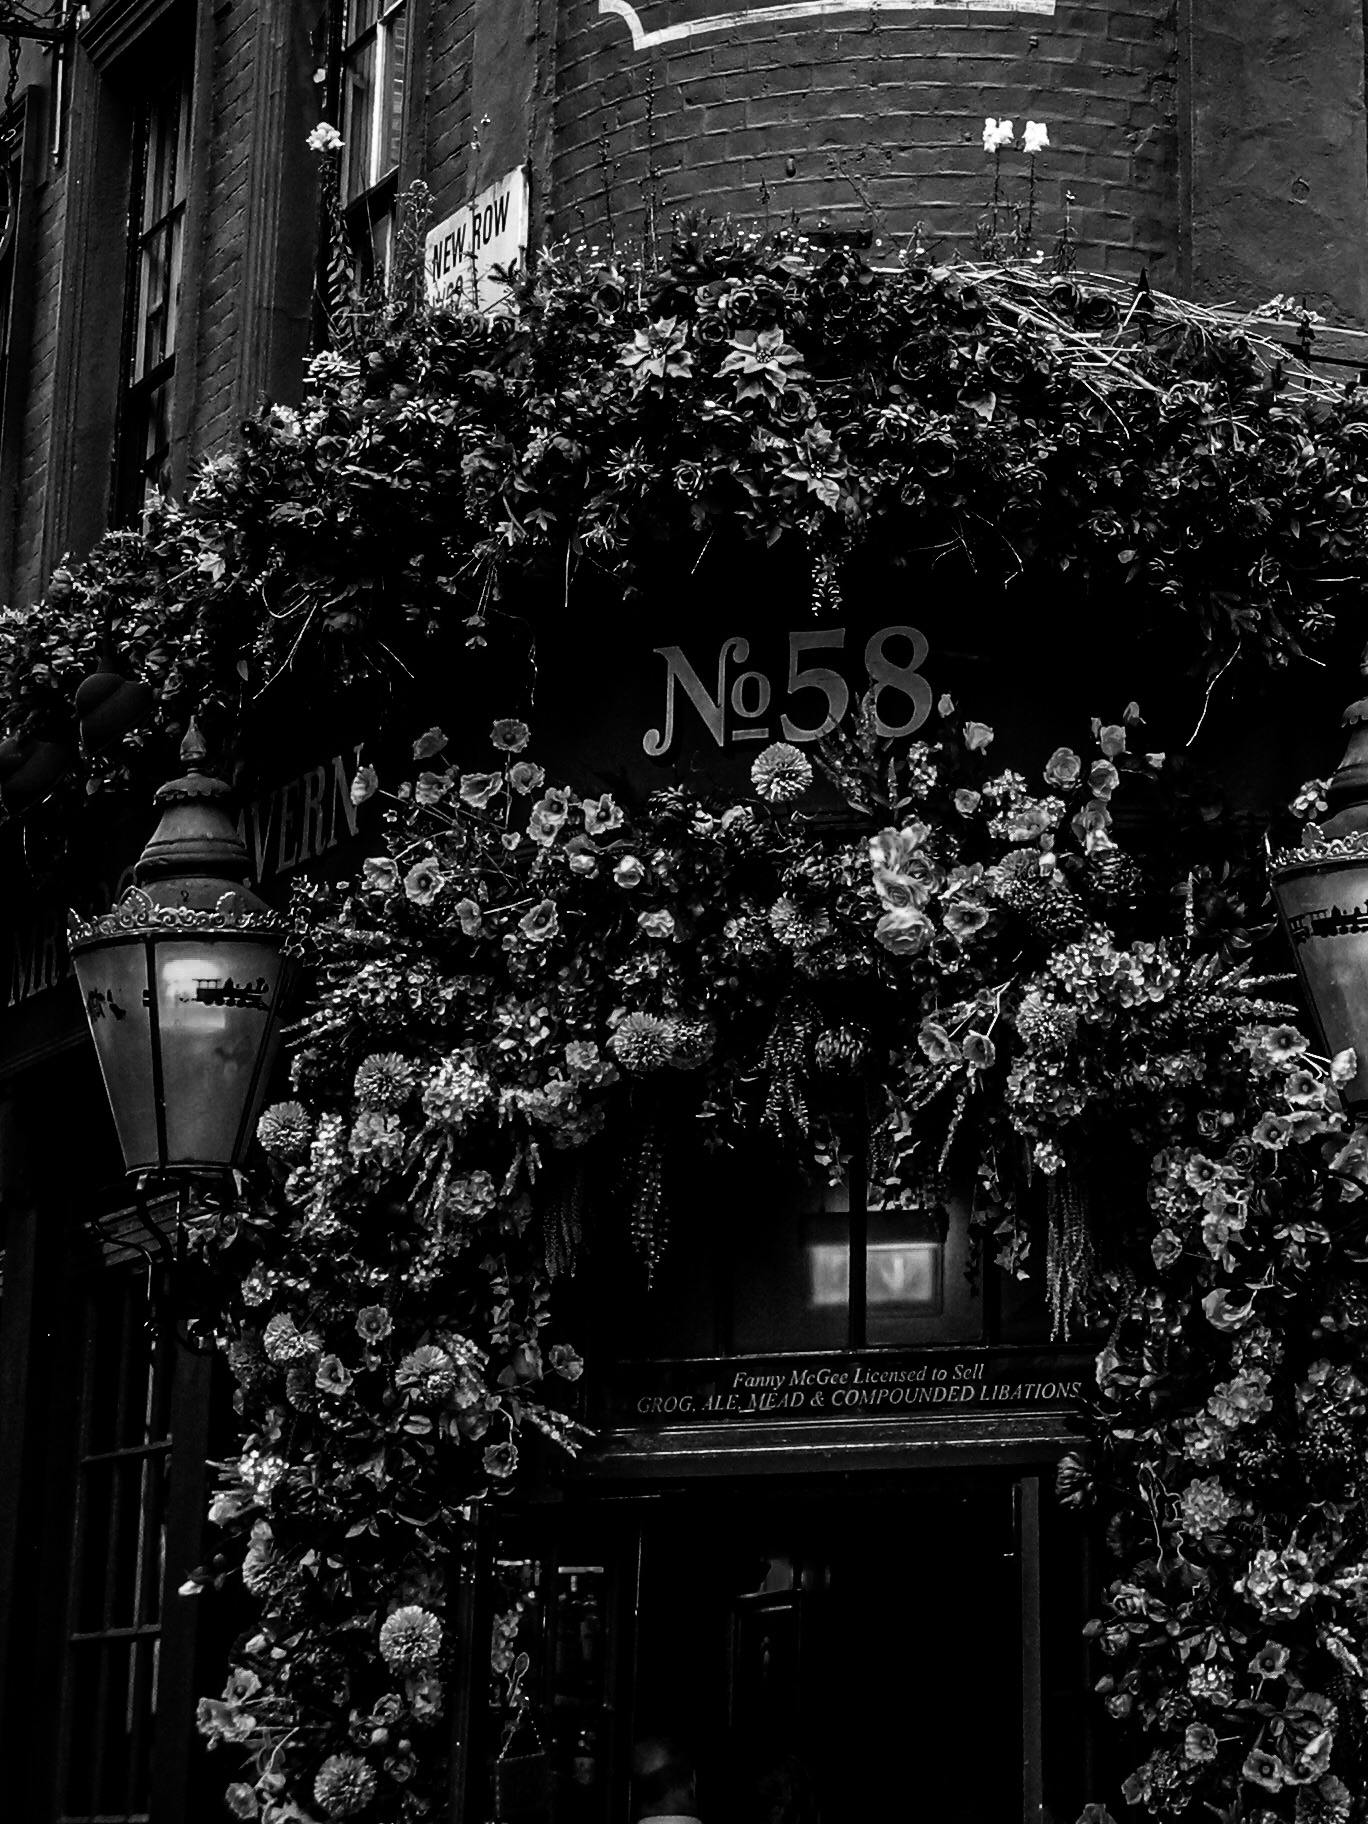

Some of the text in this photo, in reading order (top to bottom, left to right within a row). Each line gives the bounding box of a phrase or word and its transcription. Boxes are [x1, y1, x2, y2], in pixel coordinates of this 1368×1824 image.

[432, 190, 511, 280] NEW ROW
[732, 1363, 985, 1391] Fanny McGee Licensed to Sell
[747, 1391, 805, 1410] MEAD
[809, 1390, 826, 1407] &
[831, 1385, 975, 1407] COMPOUNDED
[979, 1381, 1083, 1401] LIBATIONS
